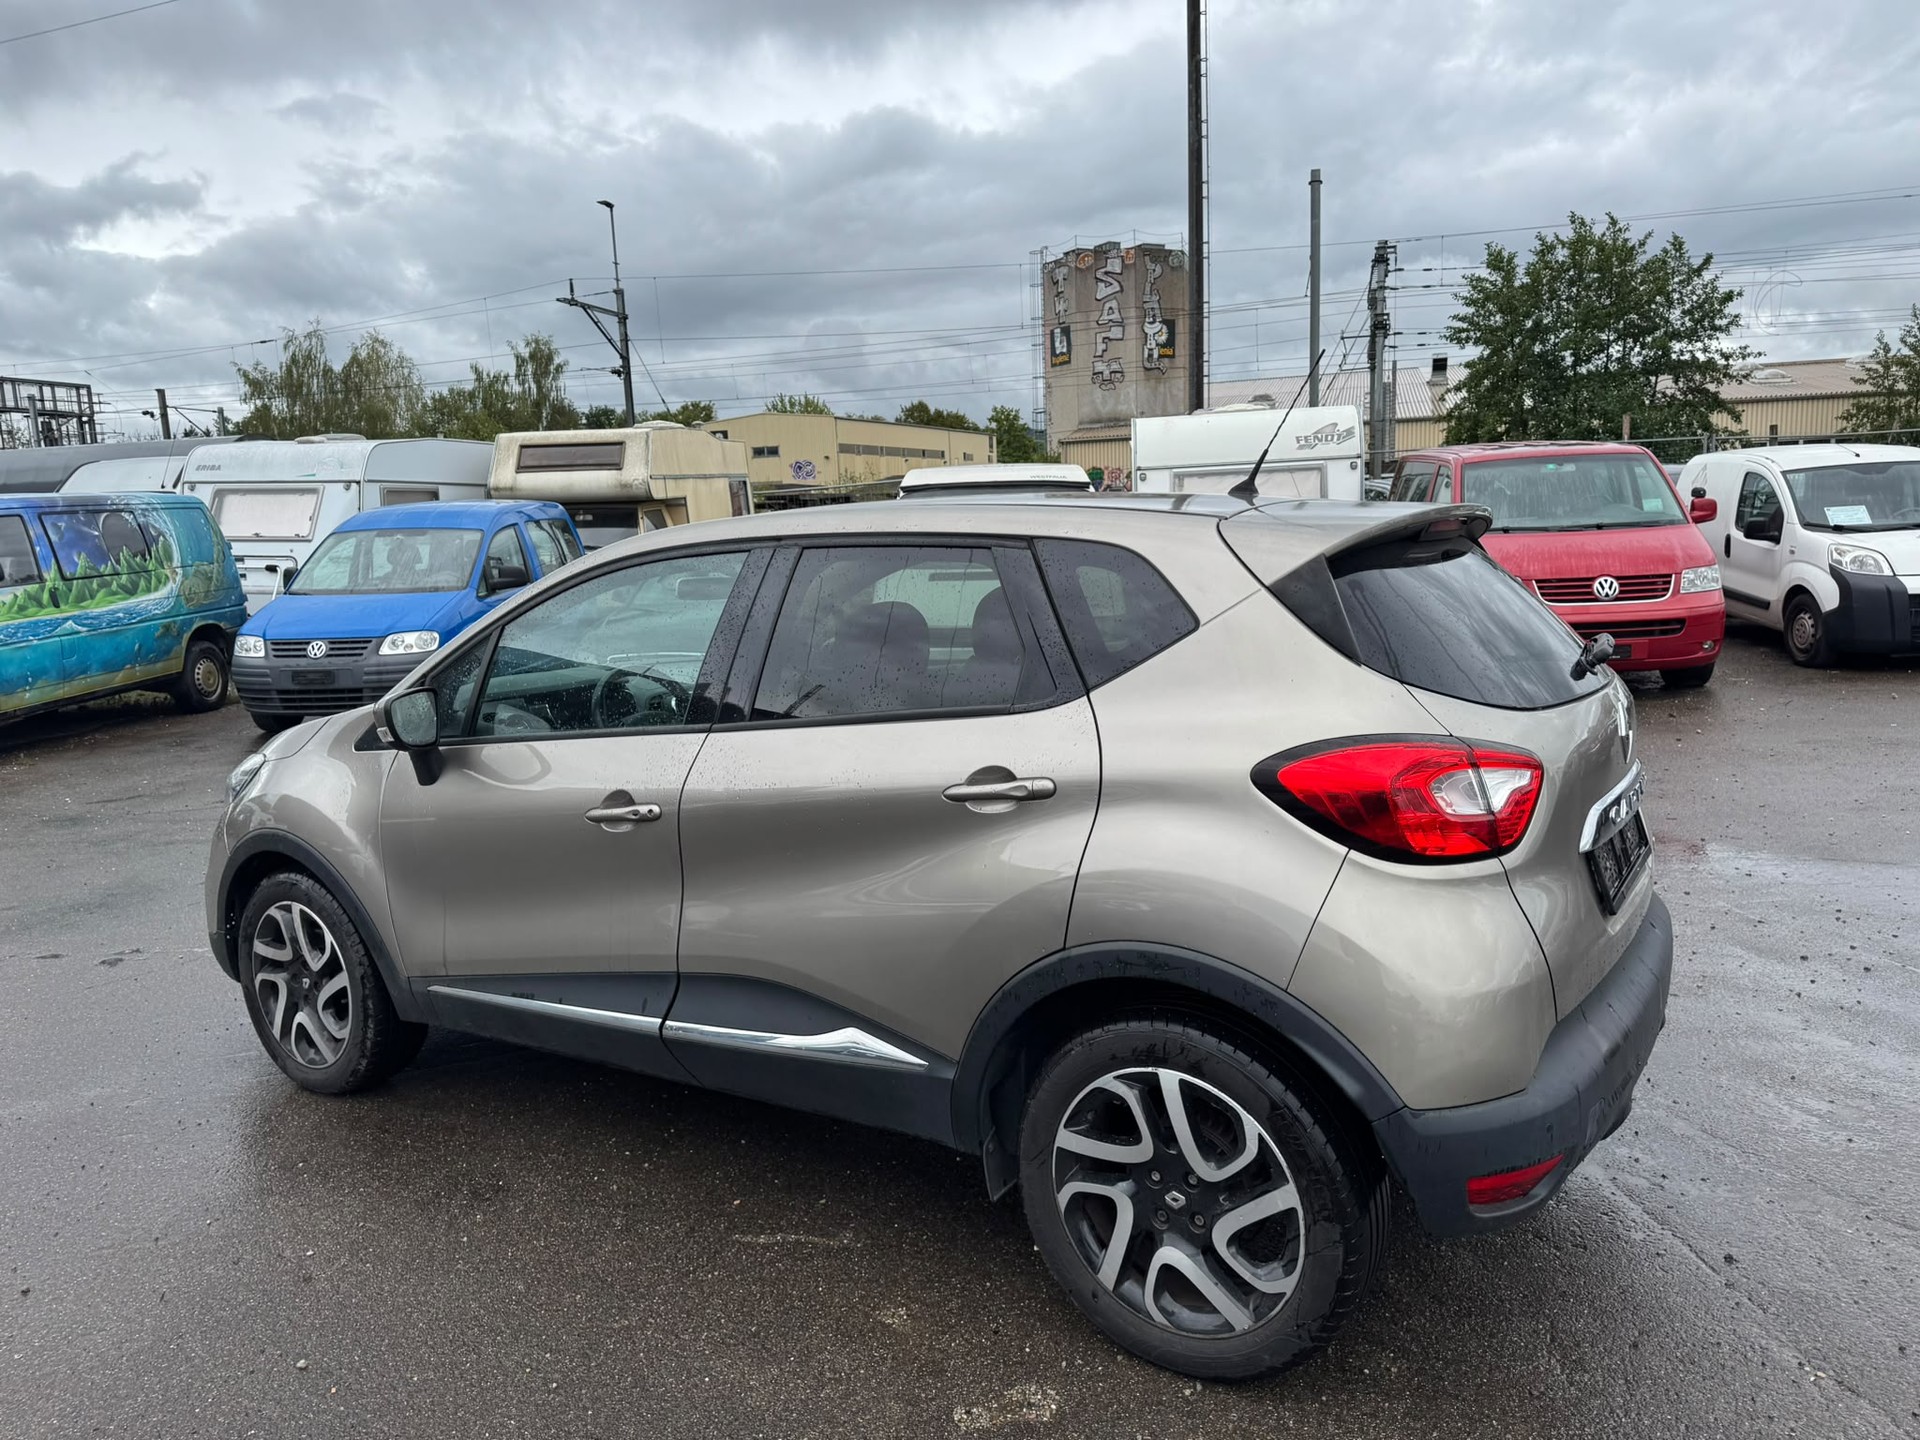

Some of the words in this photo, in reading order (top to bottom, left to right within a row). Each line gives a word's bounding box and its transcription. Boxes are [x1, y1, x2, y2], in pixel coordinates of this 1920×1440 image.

[1295, 432, 1345, 445] FENDT
[195, 464, 222, 472] ERIBA
[1593, 576, 1620, 600] VW
[307, 640, 327, 659] VW
